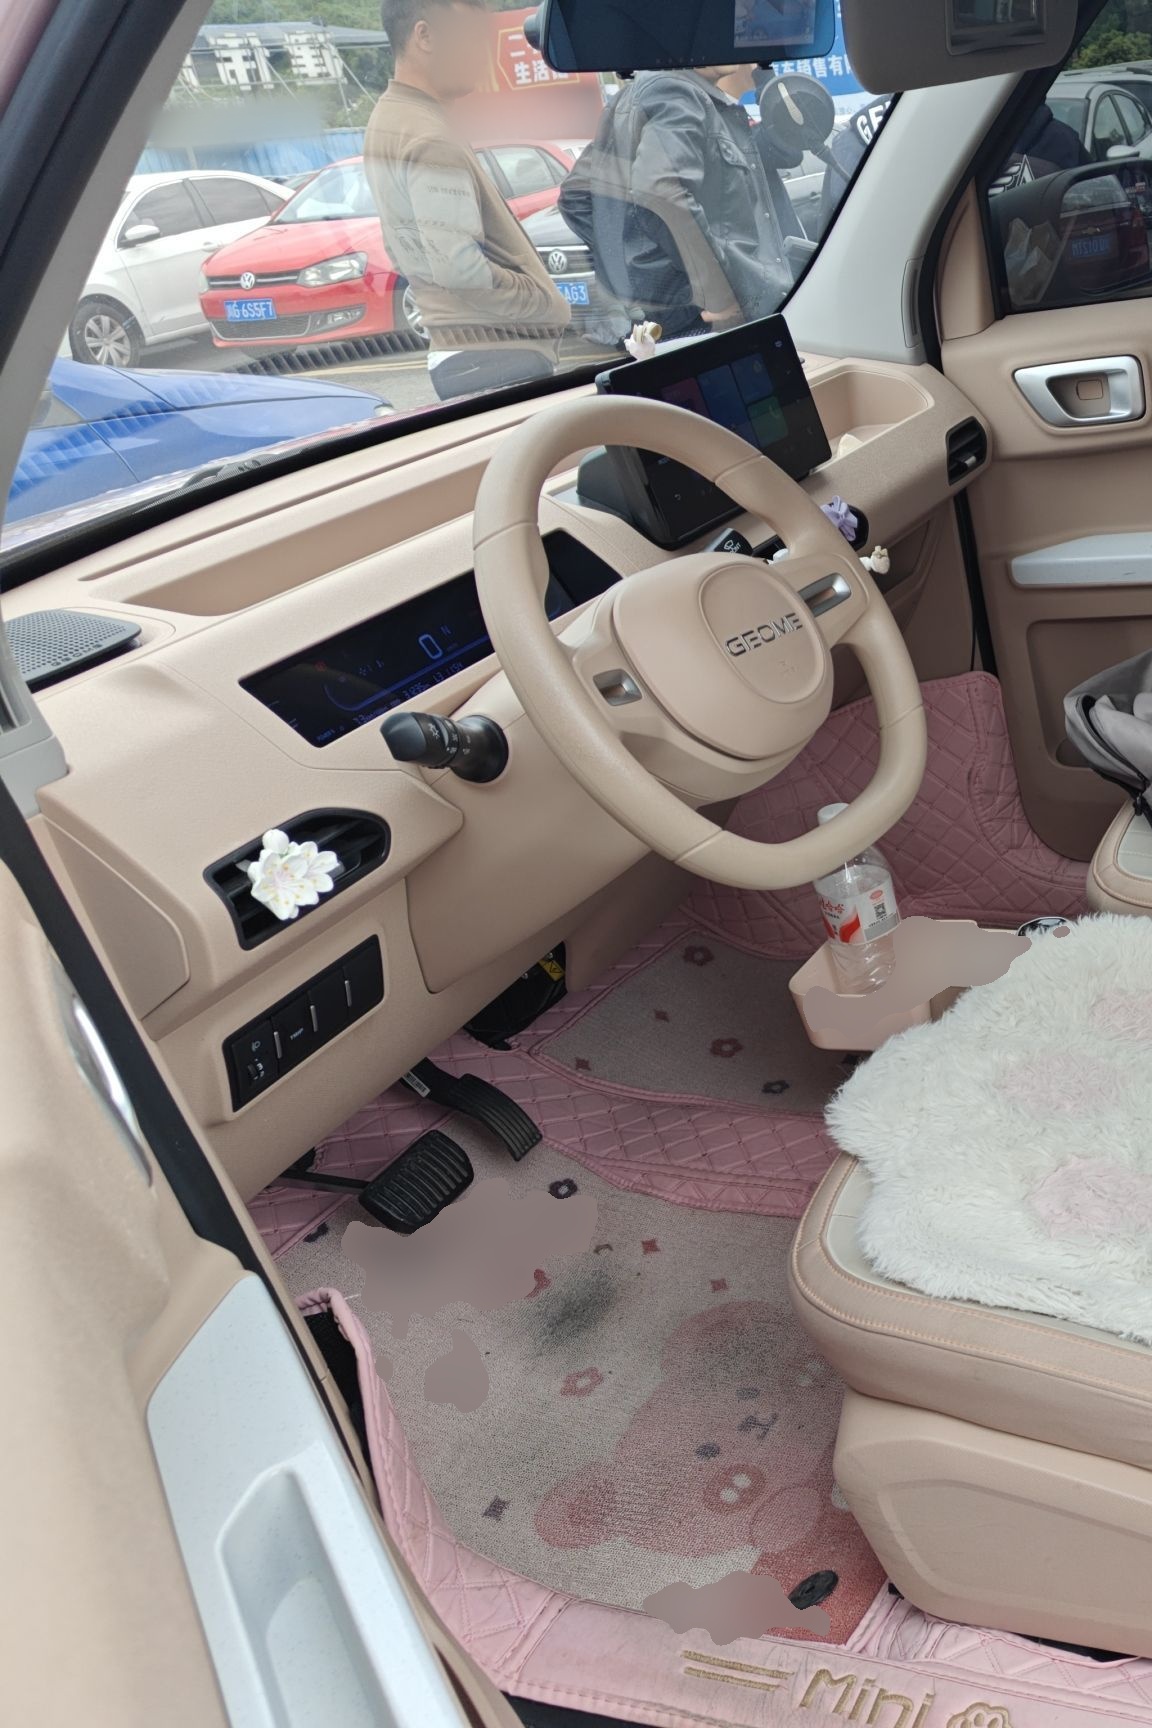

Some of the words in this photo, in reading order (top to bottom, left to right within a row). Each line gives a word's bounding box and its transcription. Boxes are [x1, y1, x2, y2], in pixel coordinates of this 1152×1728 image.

[418, 633, 443, 660] 0
[726, 612, 803, 657] GEOME
[799, 1668, 936, 1728] Mini
